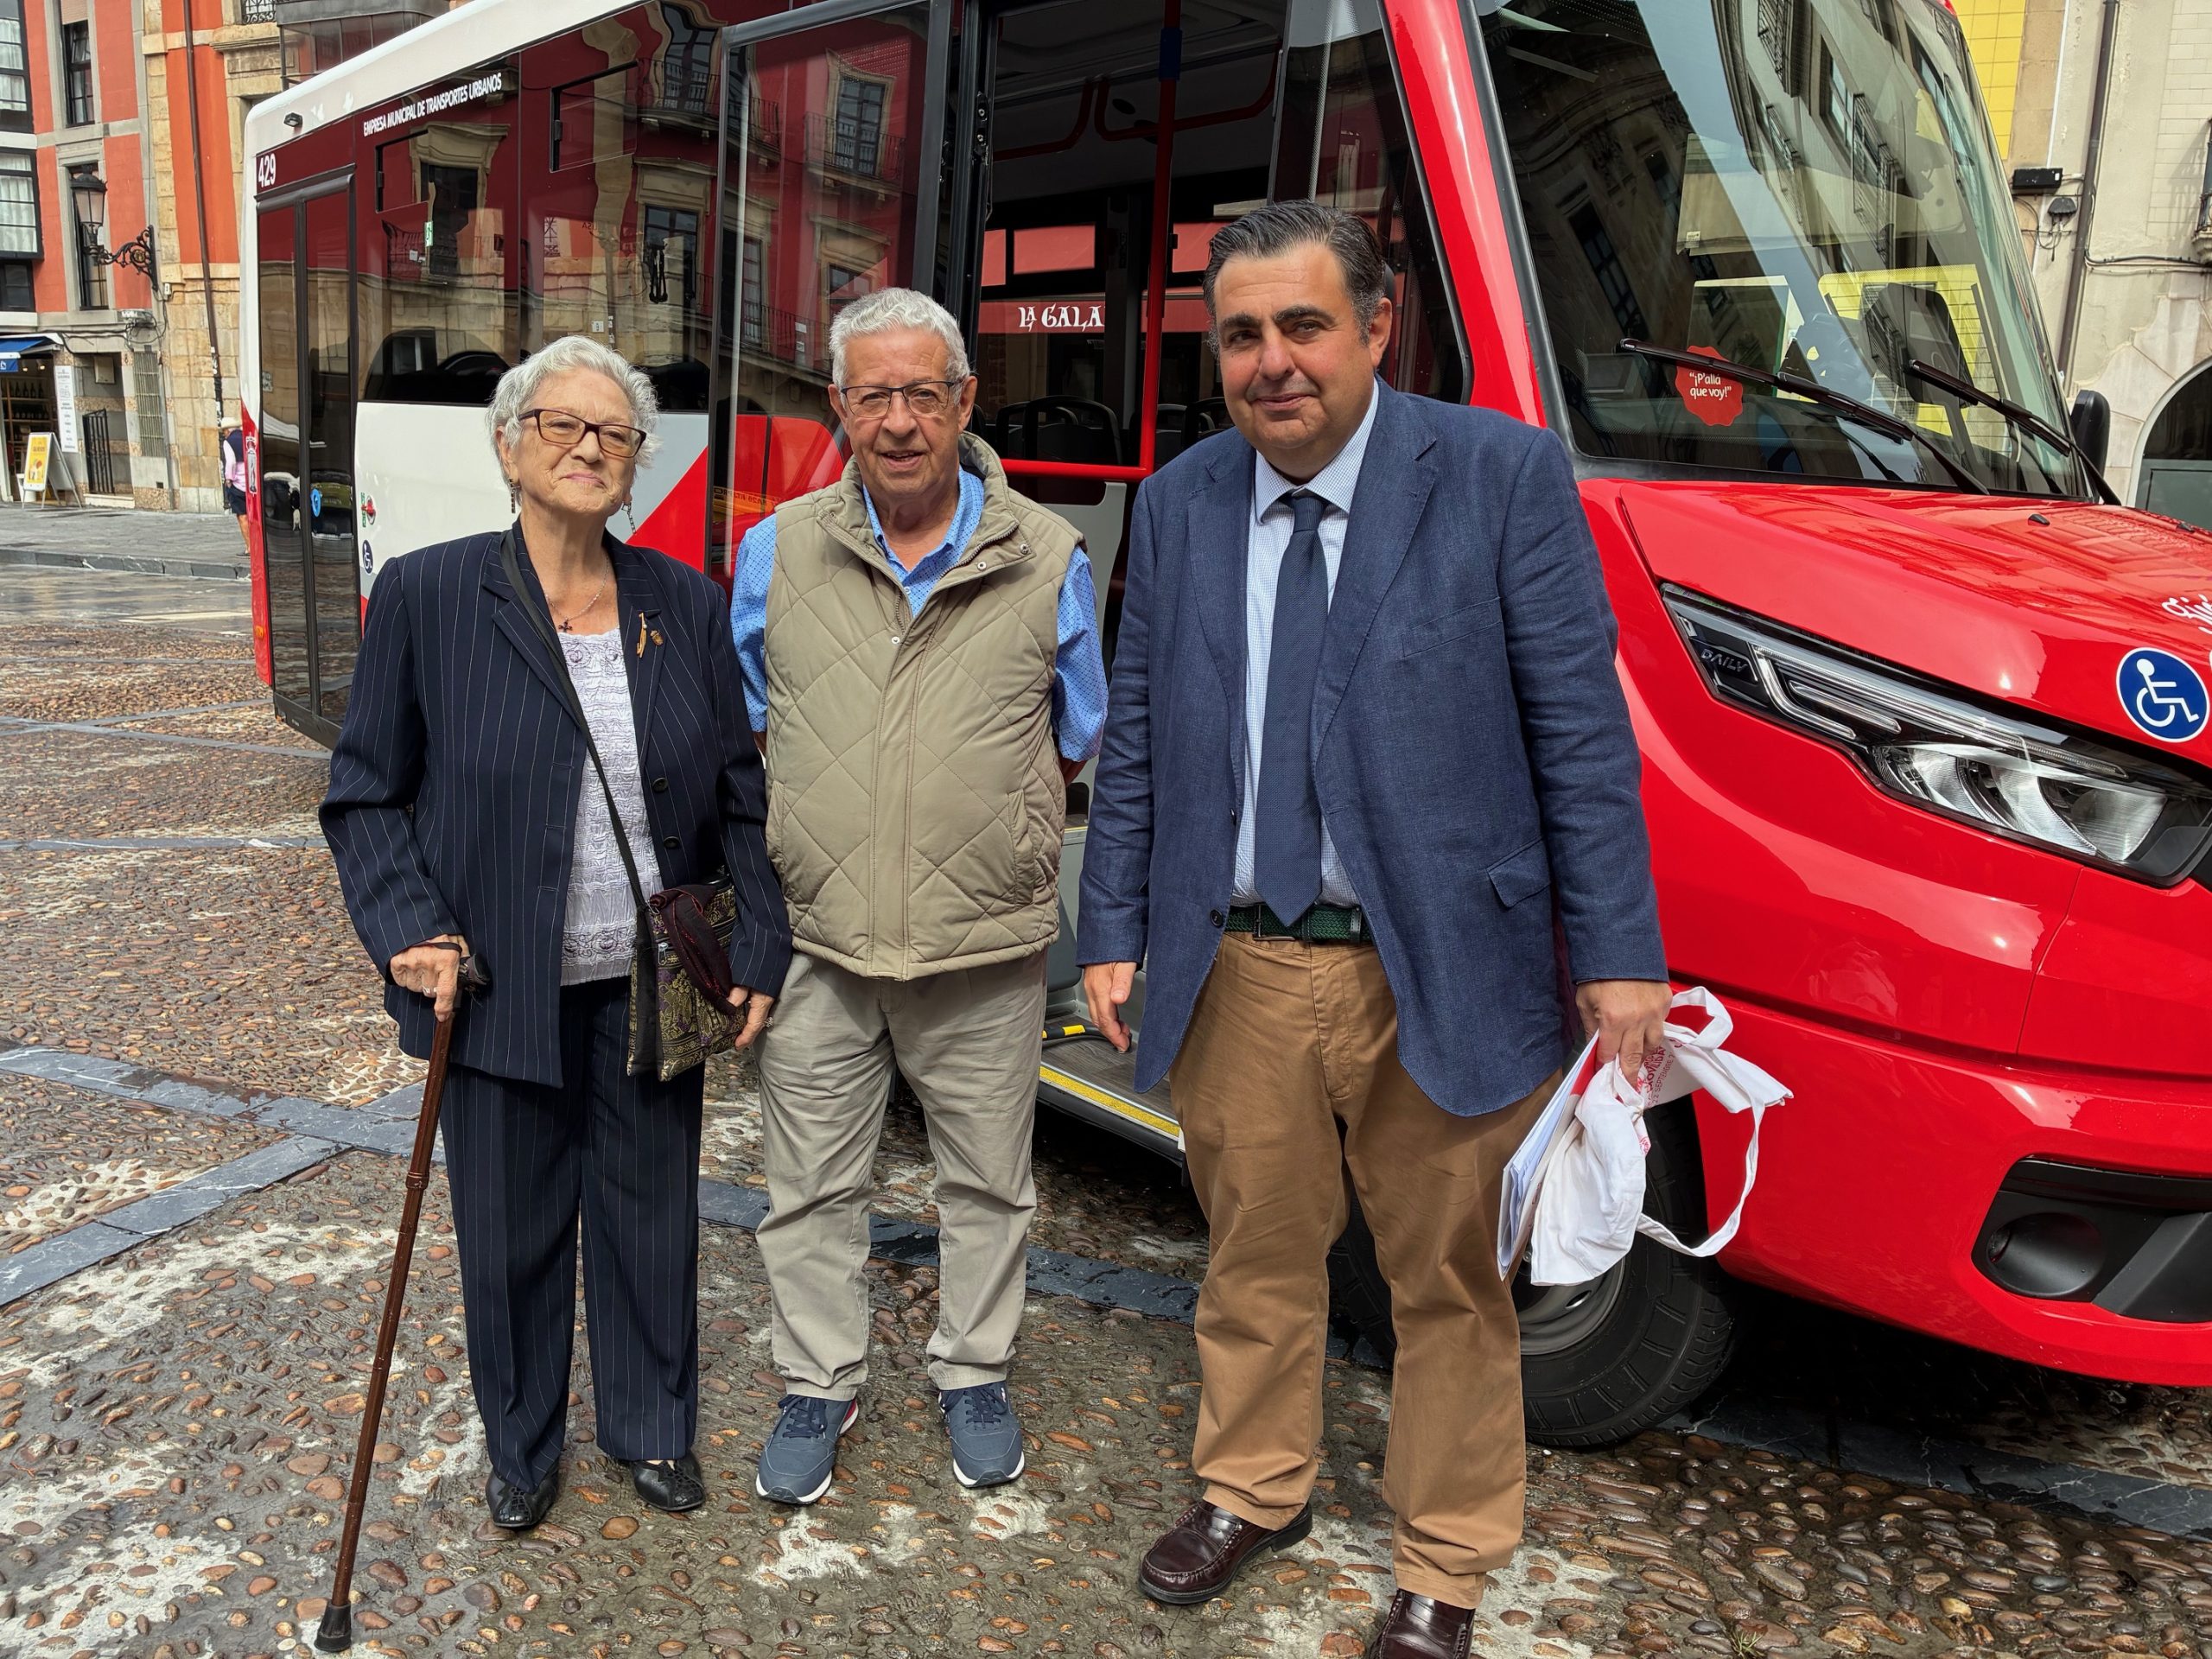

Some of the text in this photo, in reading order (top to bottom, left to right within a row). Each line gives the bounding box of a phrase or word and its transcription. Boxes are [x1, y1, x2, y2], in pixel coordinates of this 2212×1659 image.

[363, 73, 502, 137] EMPRESA MUNICIPAL DE TRANSPORTES URBANOS
[258, 153, 276, 188] 429
[1018, 303, 1105, 332] LA GALA
[1690, 387, 1707, 400] que
[1701, 648, 1748, 672] DAILY
